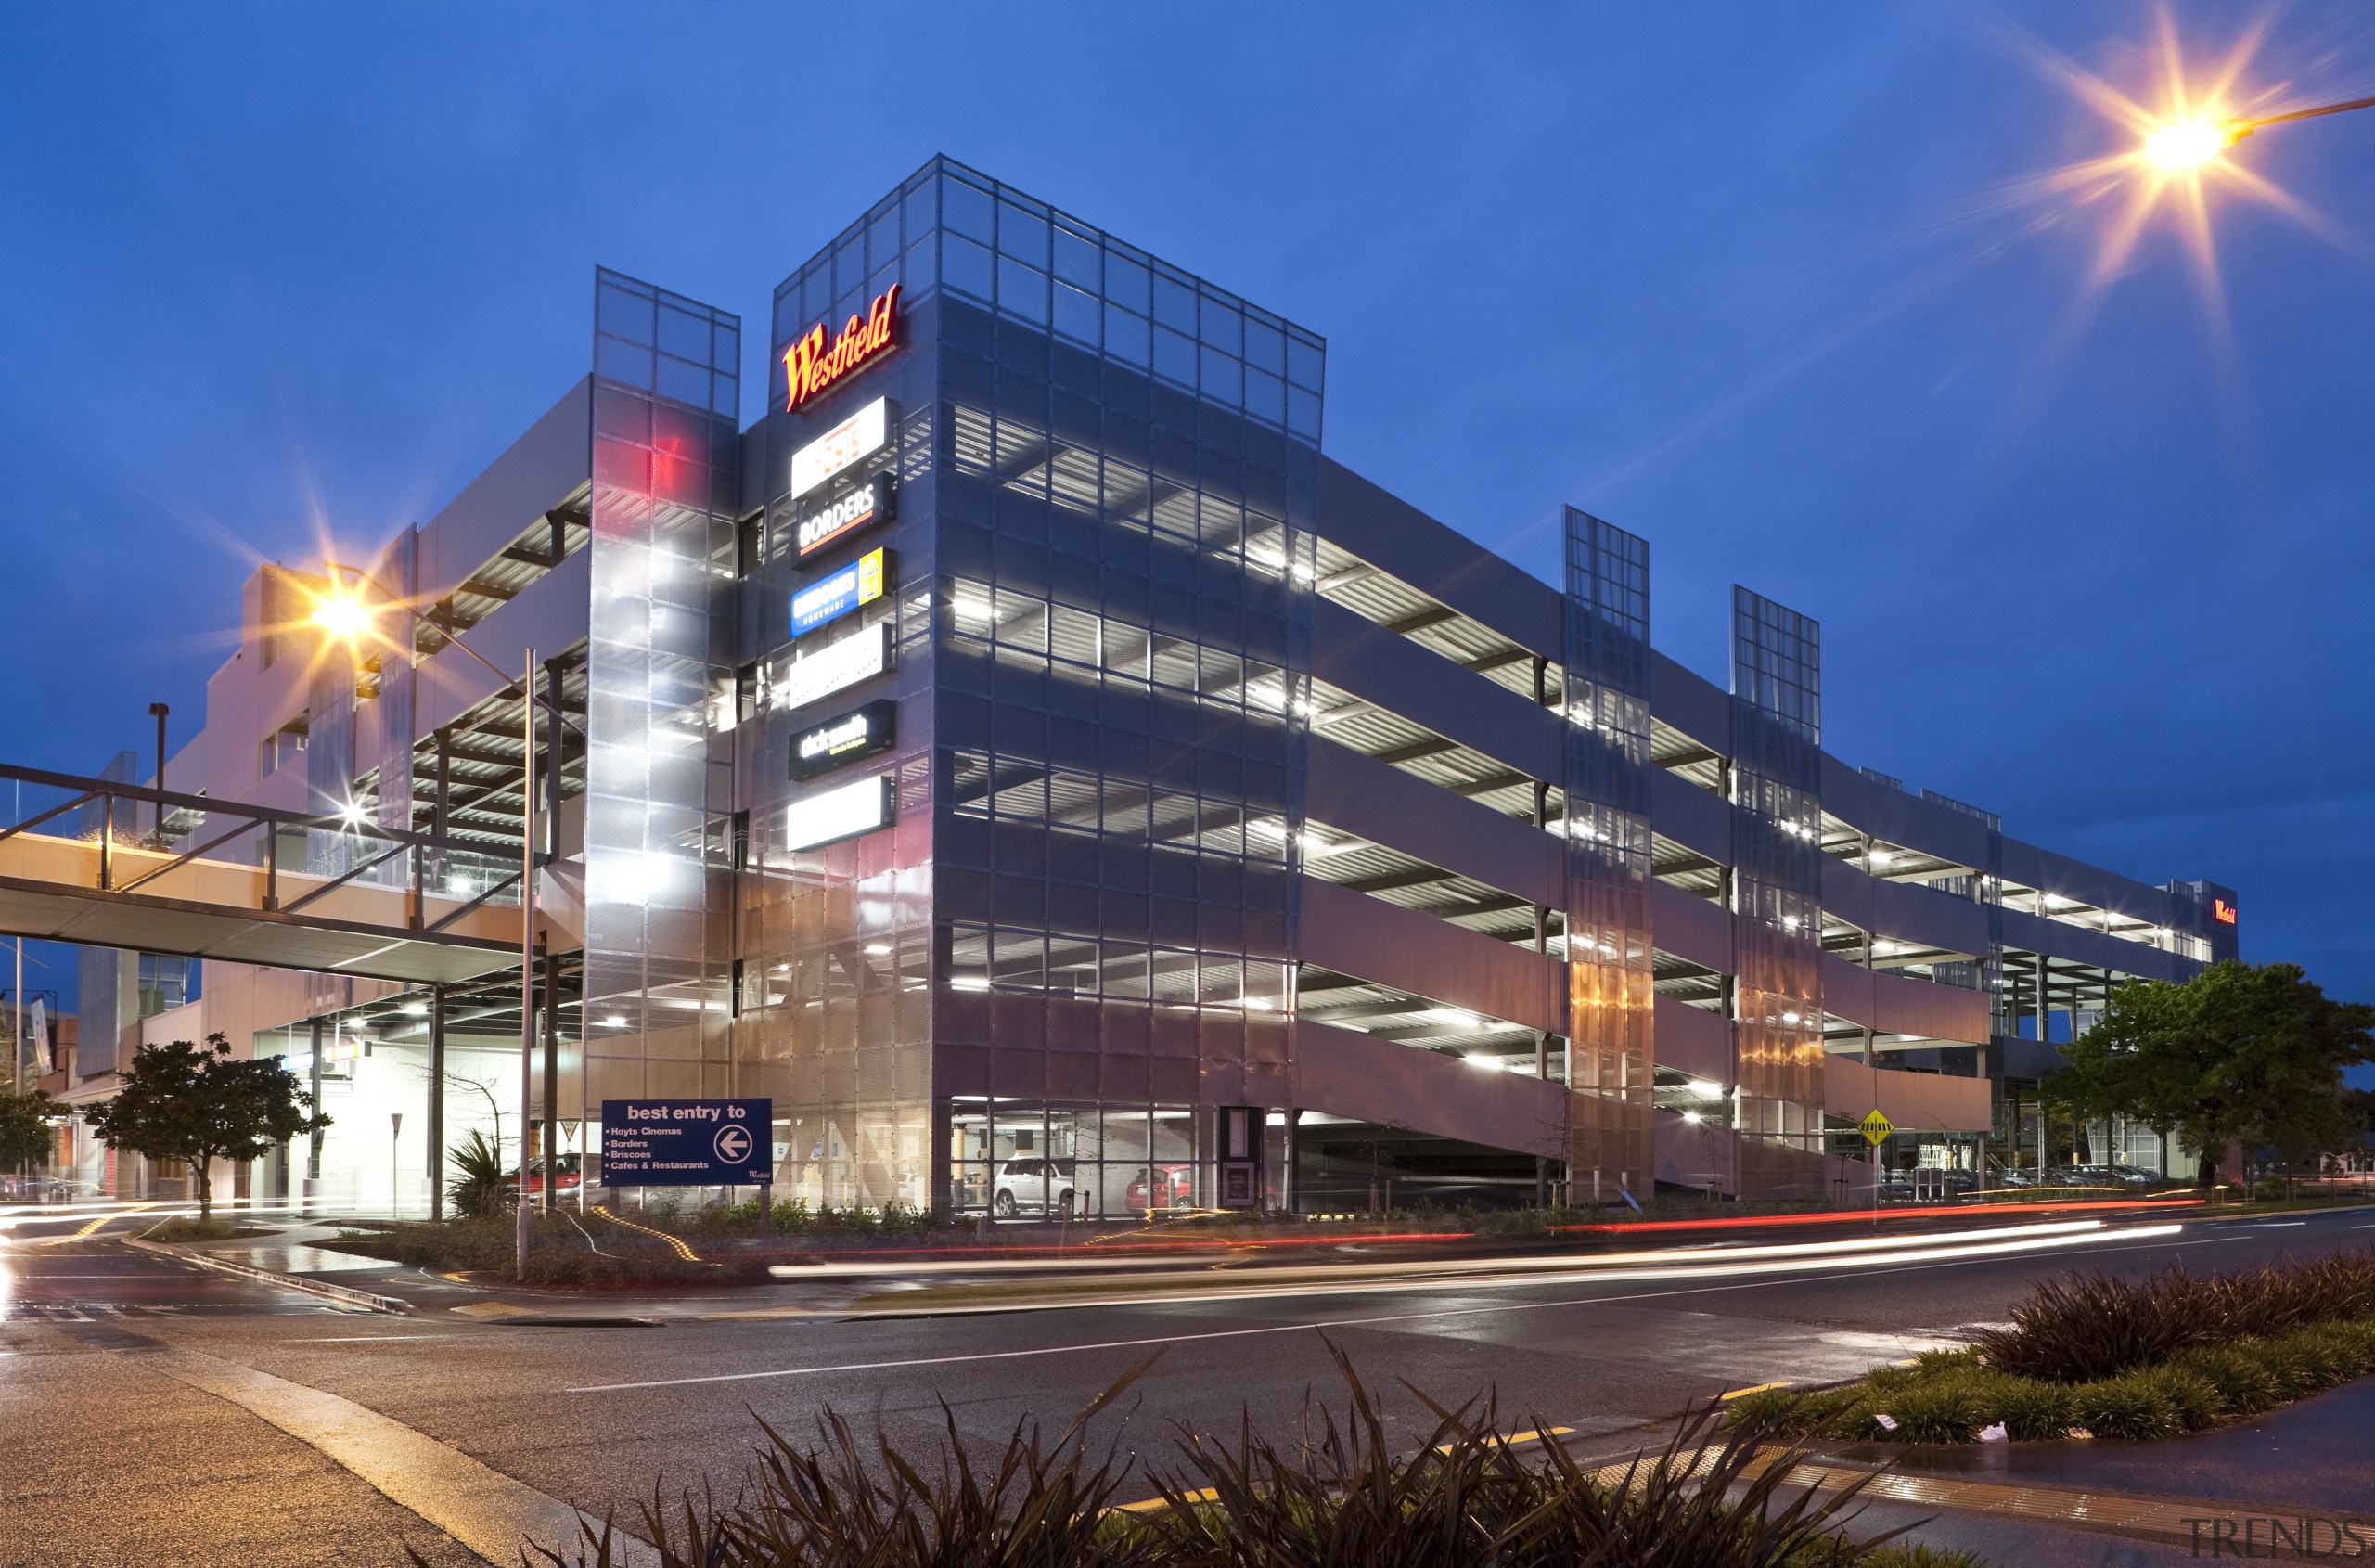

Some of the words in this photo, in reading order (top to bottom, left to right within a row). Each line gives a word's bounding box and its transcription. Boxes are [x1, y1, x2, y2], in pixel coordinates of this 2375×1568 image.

[782, 282, 900, 414] Westfield
[800, 483, 874, 548] BORDERS
[803, 598, 845, 626] HOMEWARE
[627, 1105, 669, 1119] best
[673, 1106, 721, 1122] entry
[727, 1105, 746, 1119] to
[610, 1127, 638, 1137] Hoyts
[641, 1127, 682, 1136] Cinemas
[610, 1139, 648, 1148] Borders
[610, 1150, 651, 1159] Briscoes
[610, 1162, 638, 1170] Cafes
[641, 1162, 649, 1170] &
[652, 1162, 709, 1170] Restaurants
